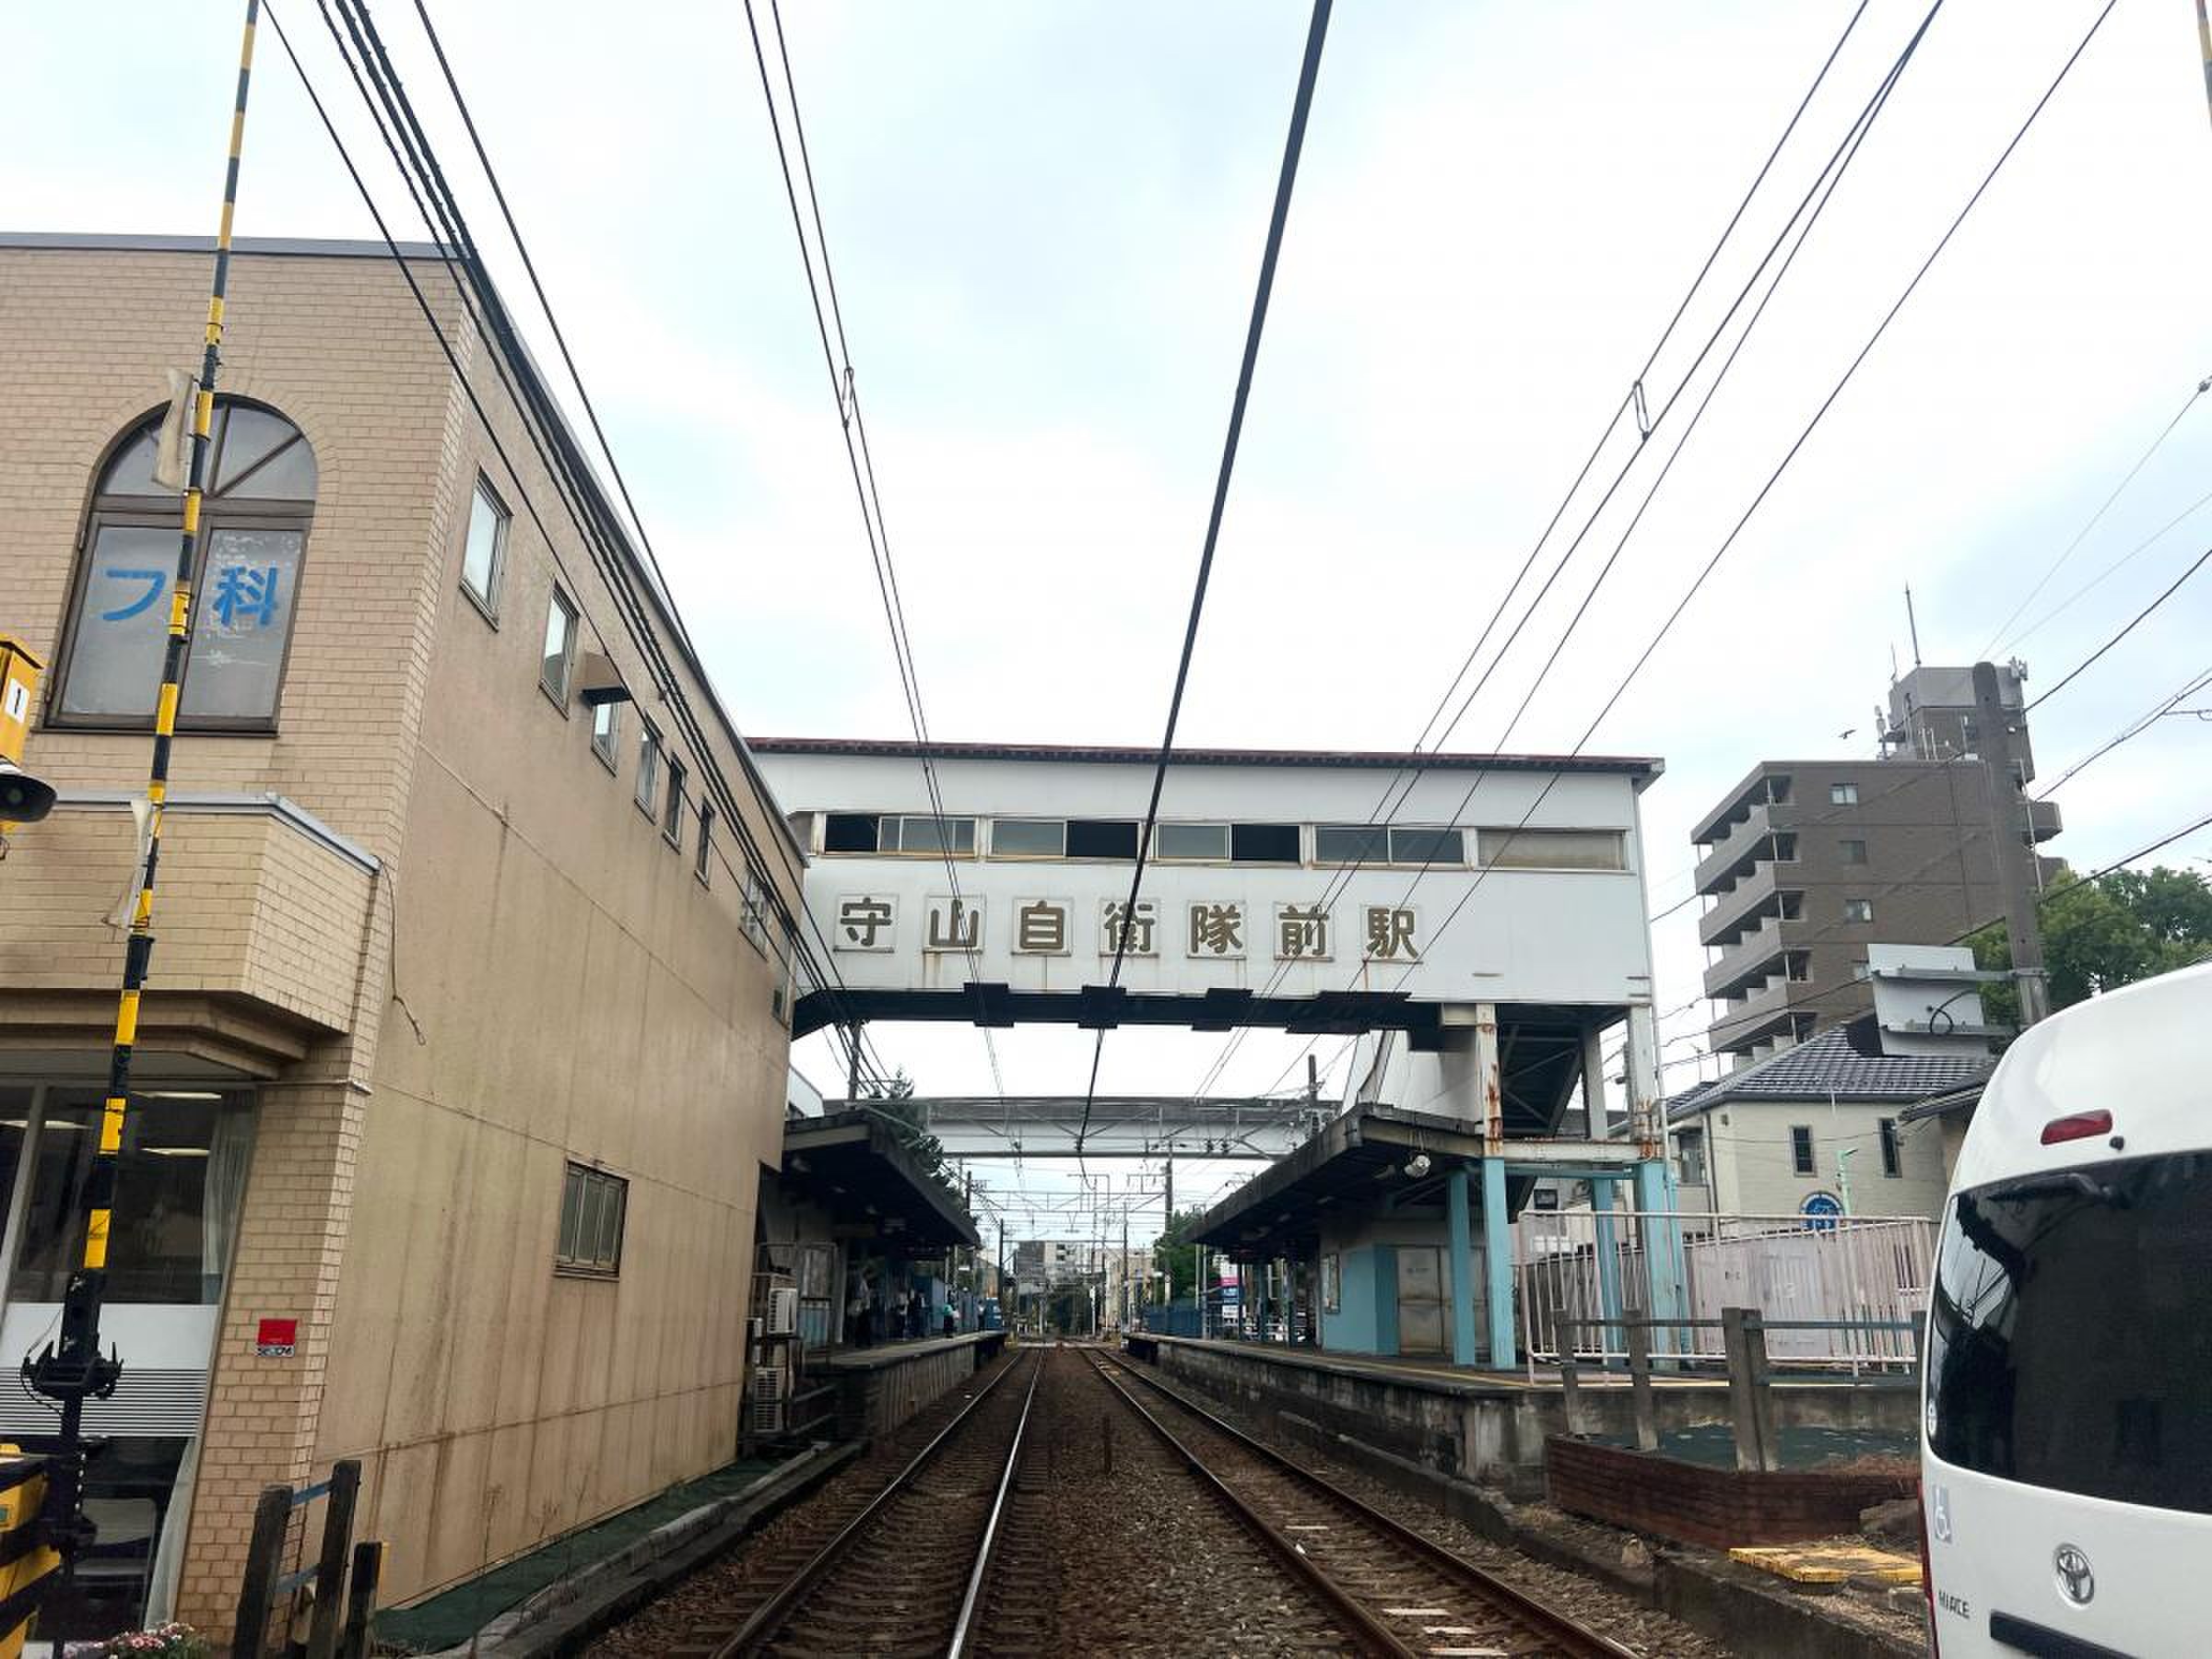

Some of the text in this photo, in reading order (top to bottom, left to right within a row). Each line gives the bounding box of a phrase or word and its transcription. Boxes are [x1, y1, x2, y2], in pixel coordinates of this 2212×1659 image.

[840, 897, 1418, 959] 守山自衛隊前駅
